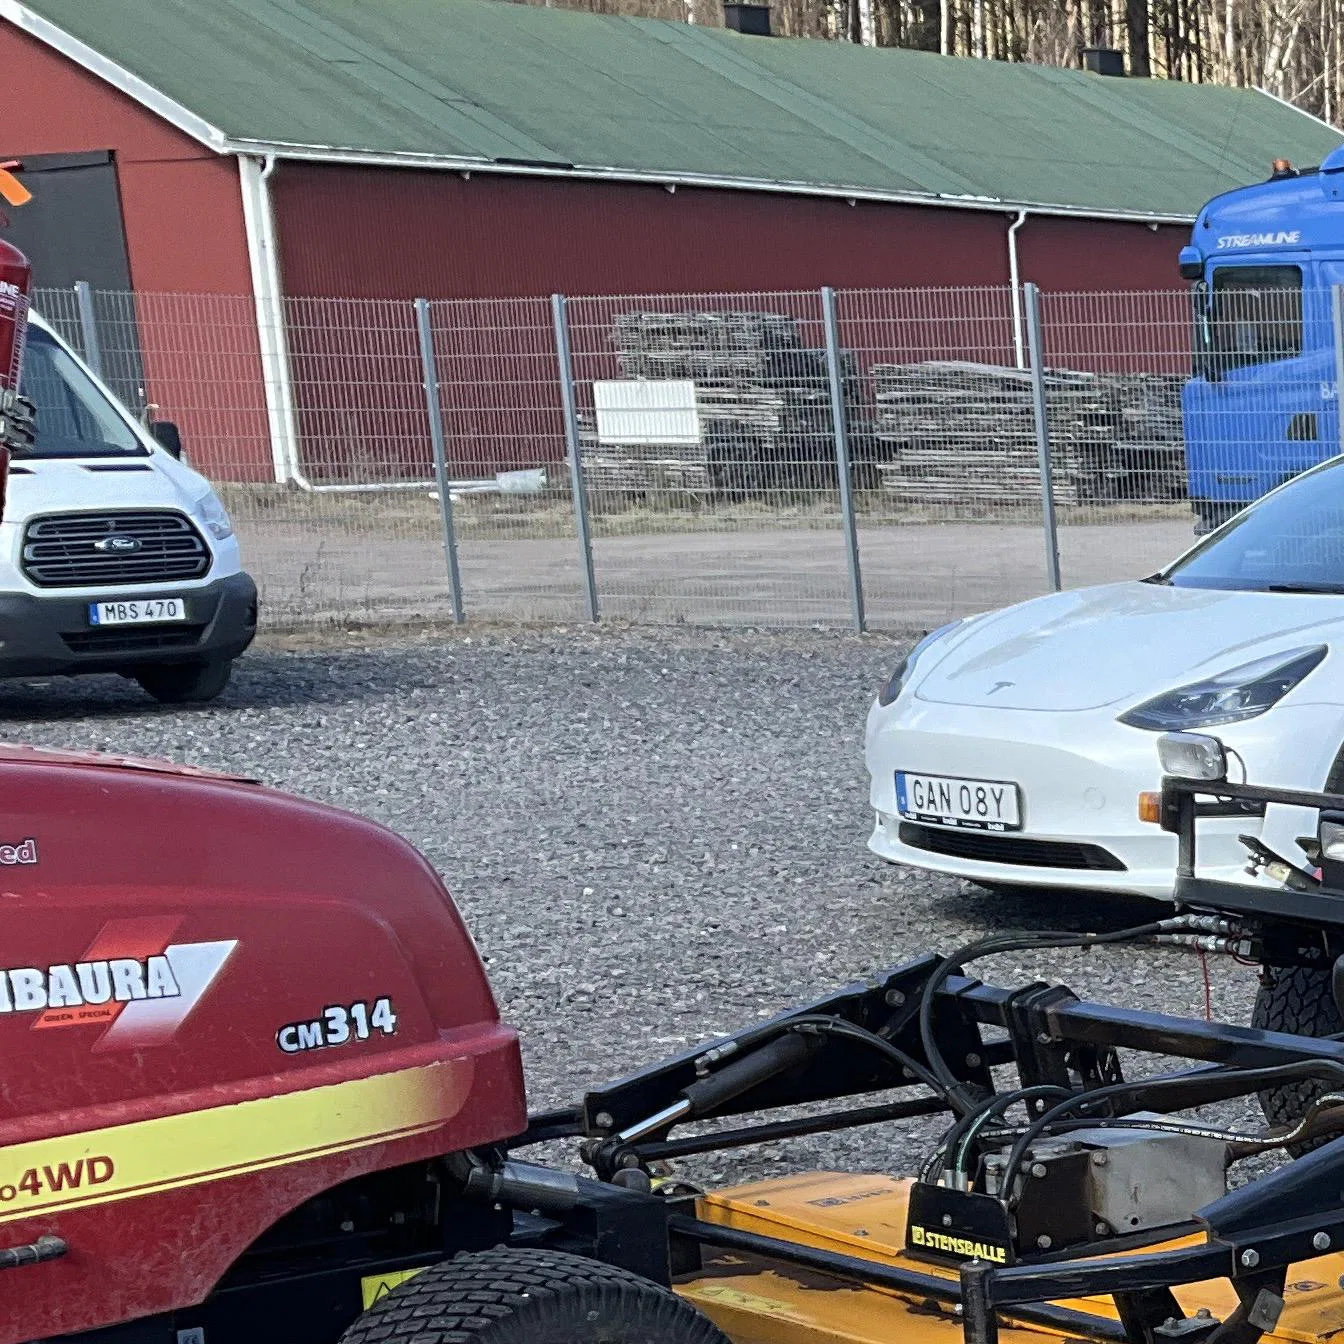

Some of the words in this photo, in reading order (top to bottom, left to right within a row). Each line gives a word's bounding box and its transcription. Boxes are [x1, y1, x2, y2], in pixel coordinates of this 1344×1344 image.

[1217, 231, 1301, 249] STREAMLINE
[104, 603, 139, 620] MBS
[145, 601, 177, 618] 470
[913, 779, 952, 814] GAN
[960, 784, 1004, 819] 08Y
[278, 998, 398, 1053] CM314
[925, 1231, 1006, 1264] STENSBALLE
